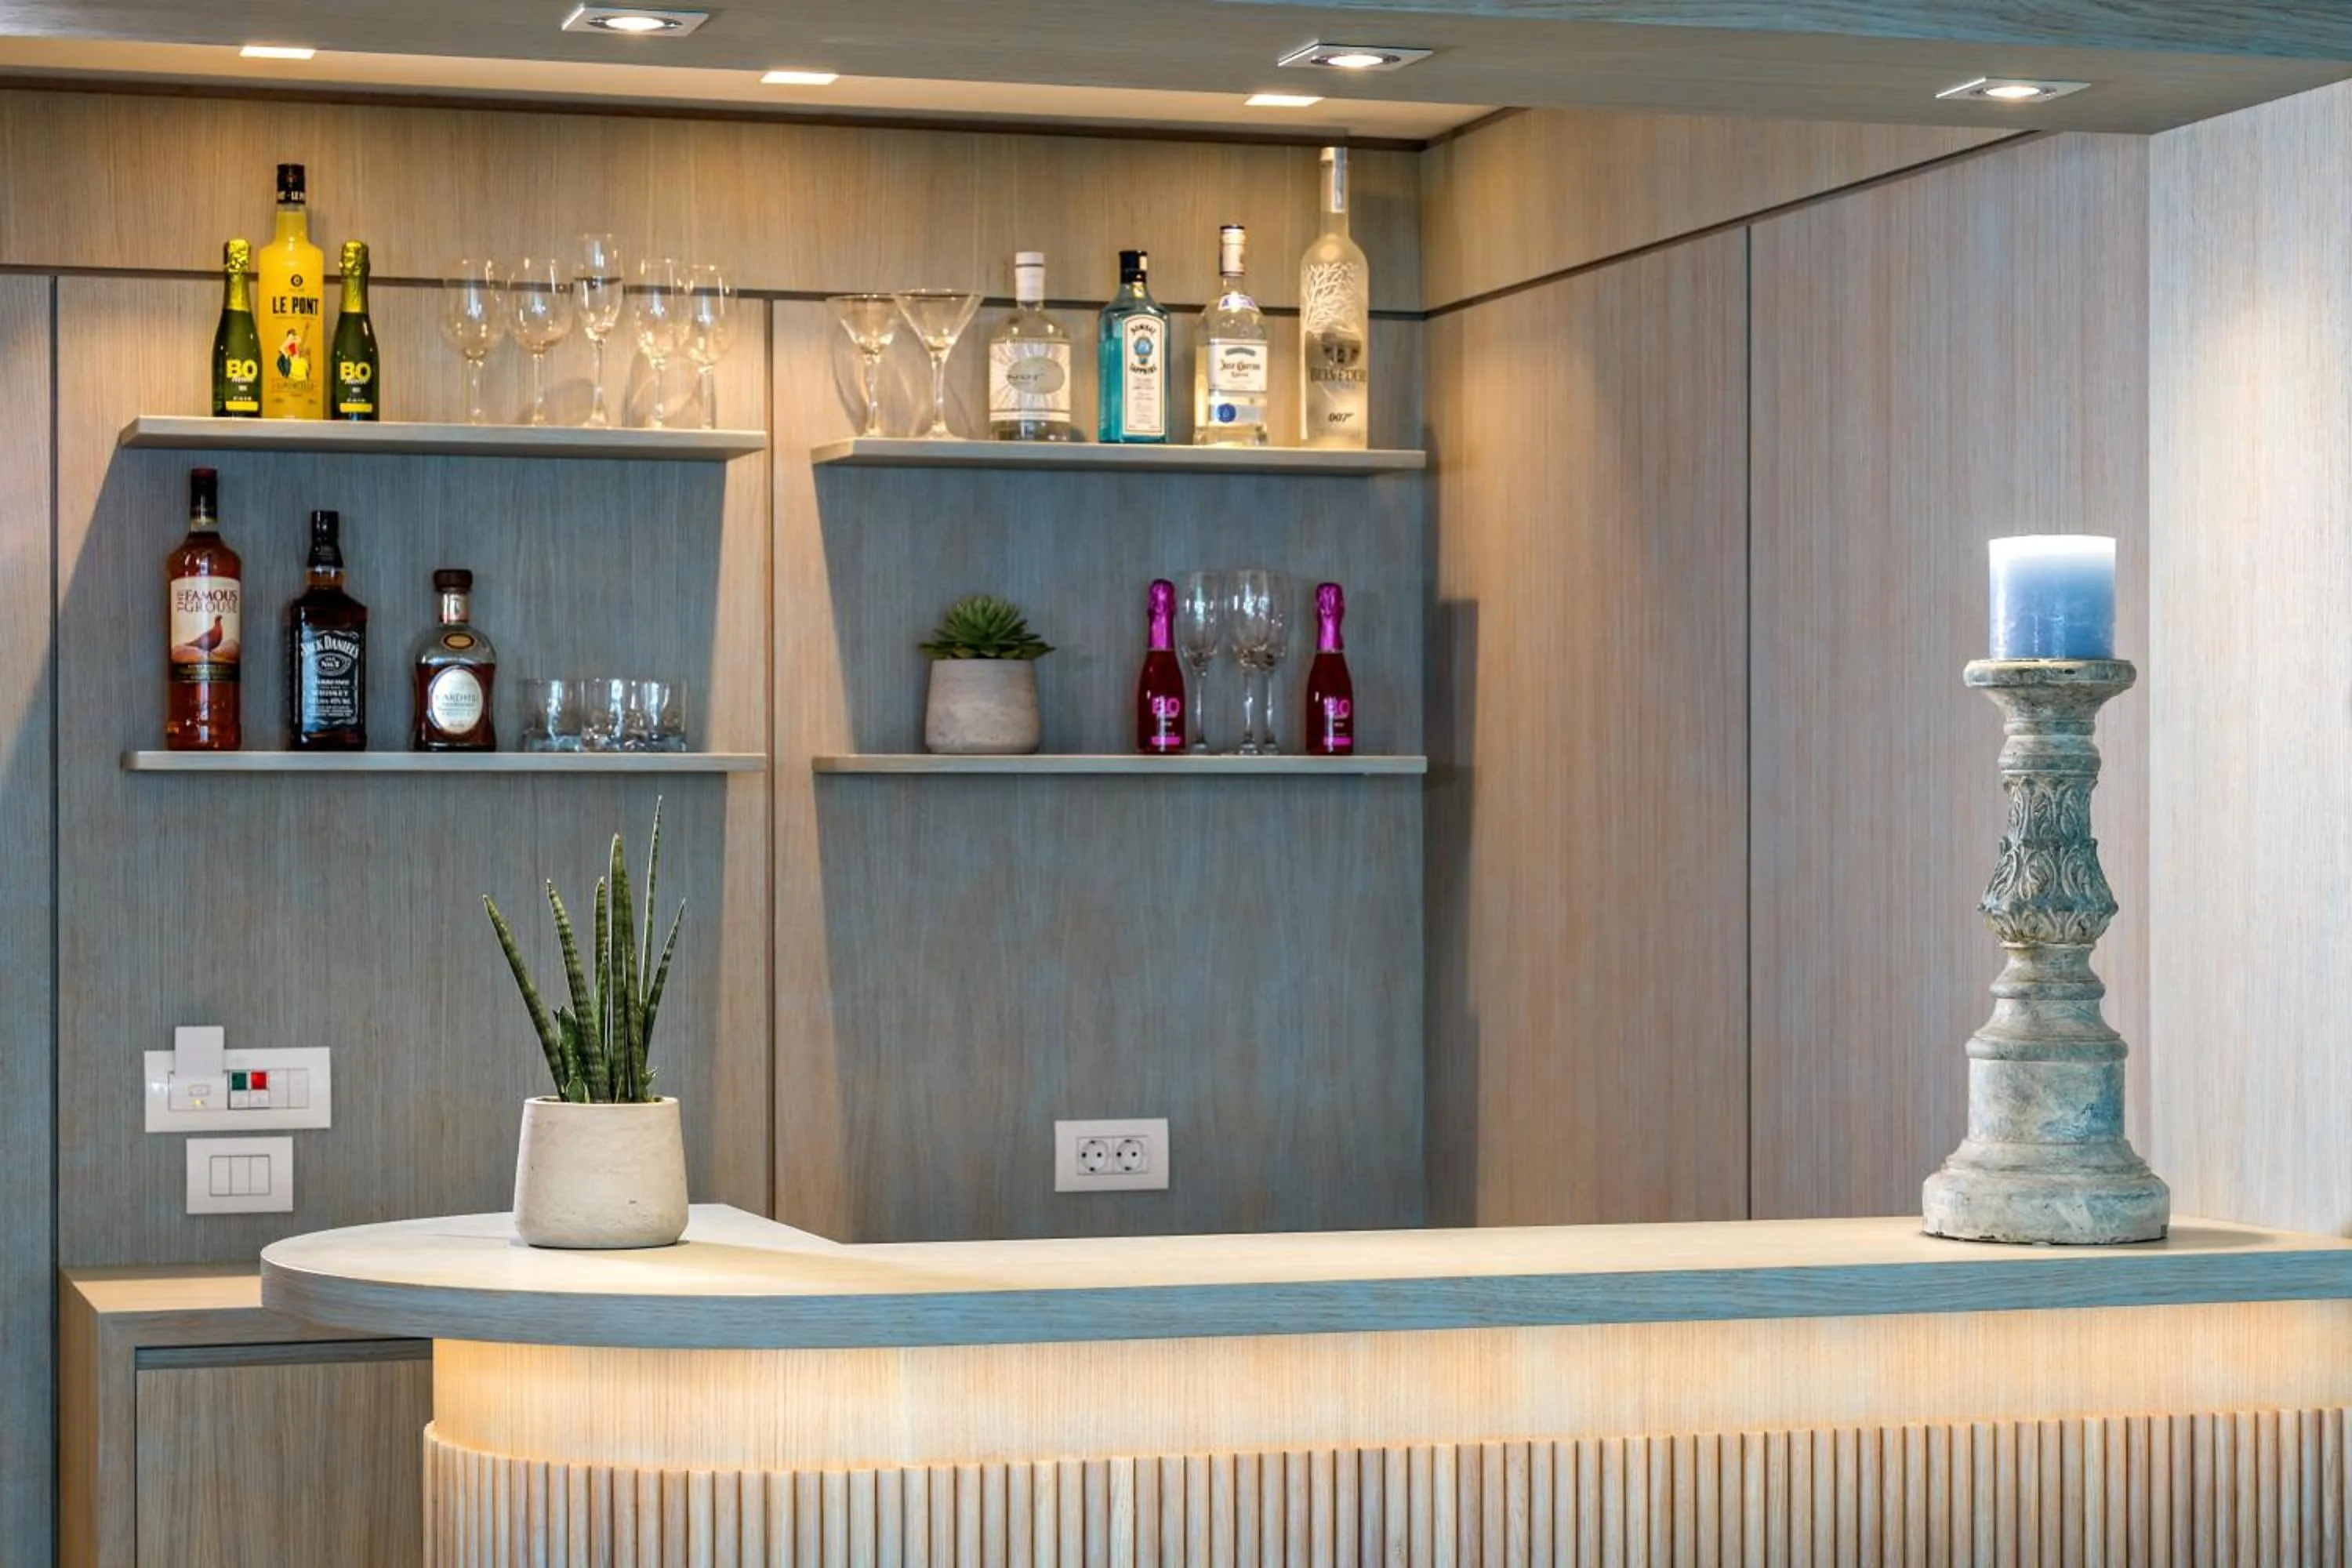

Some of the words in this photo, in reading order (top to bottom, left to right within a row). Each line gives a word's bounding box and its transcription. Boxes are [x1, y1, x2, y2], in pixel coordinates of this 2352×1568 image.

[272, 296, 288, 314] LE
[292, 297, 319, 315] PONT
[227, 359, 258, 382] BO
[339, 361, 372, 384] BO
[1327, 412, 1355, 423] 007
[185, 589, 238, 602] FAMOUS
[183, 601, 238, 614] GROUSE
